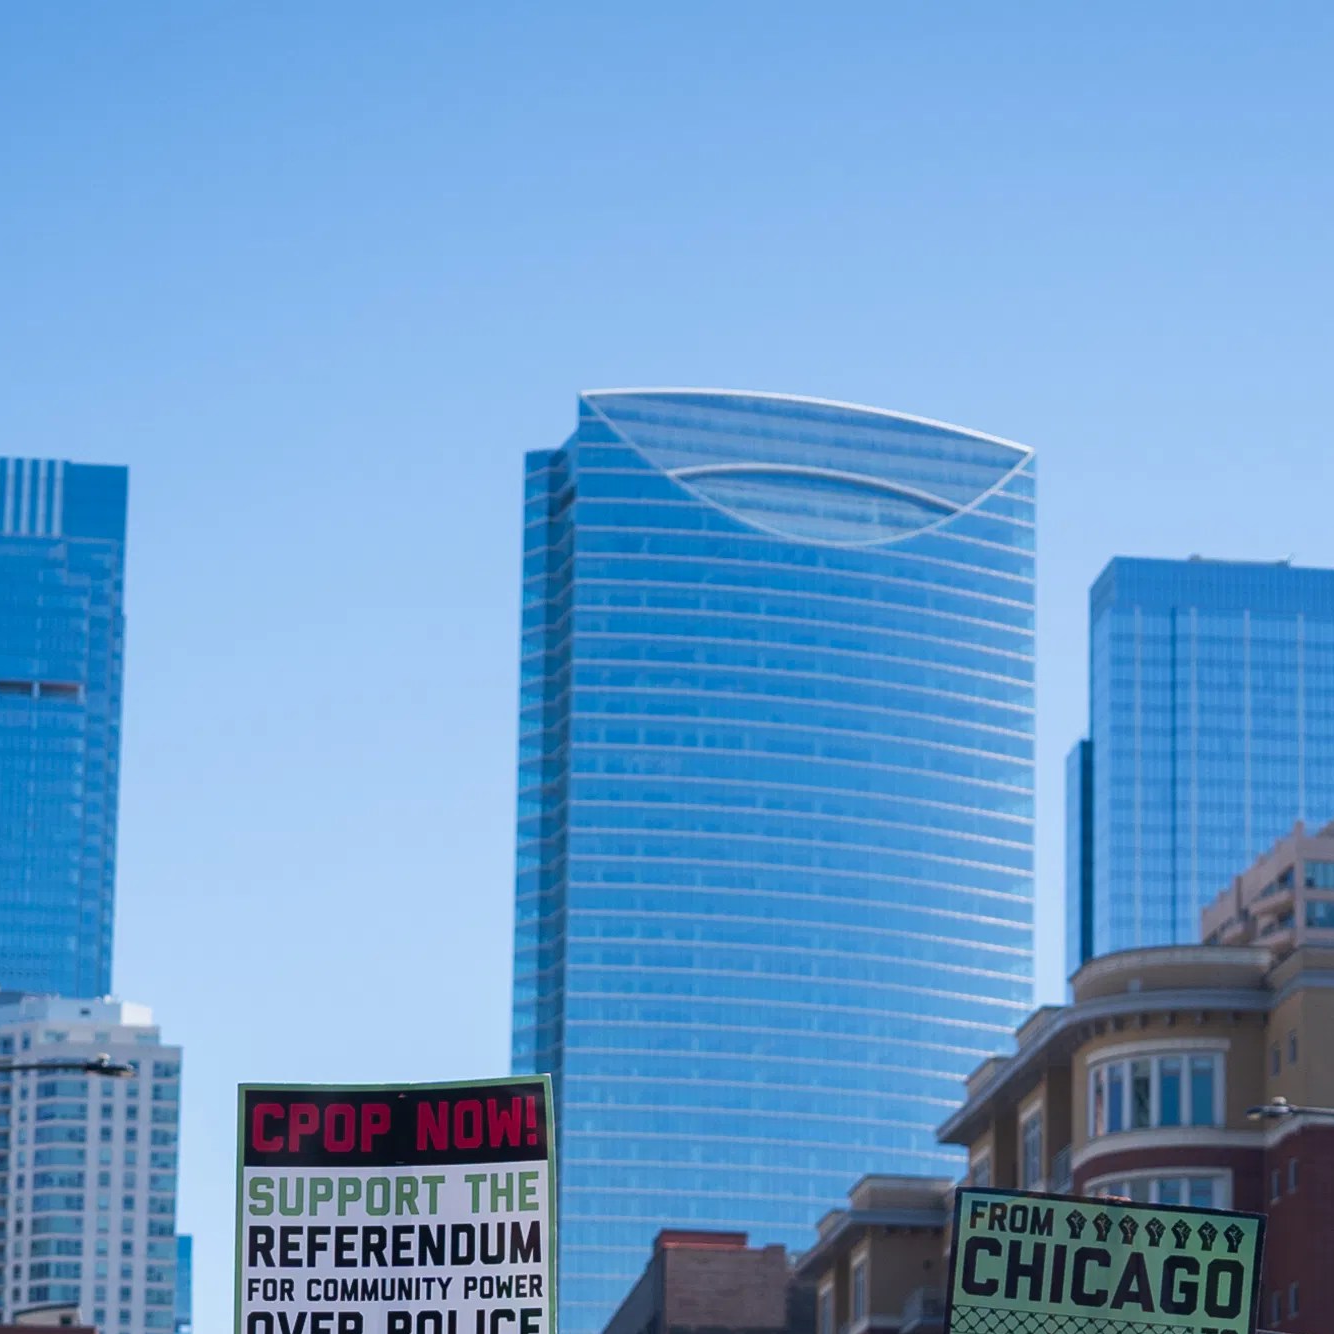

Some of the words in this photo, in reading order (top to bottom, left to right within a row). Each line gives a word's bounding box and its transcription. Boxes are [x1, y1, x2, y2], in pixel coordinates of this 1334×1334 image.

[252, 1102, 391, 1153] CPOP
[416, 1095, 538, 1151] NOW!
[247, 1175, 446, 1216] SUPPORT
[464, 1171, 540, 1214] THE
[969, 1200, 1055, 1237] FROM
[247, 1220, 542, 1267] REFERENDUM
[247, 1278, 295, 1302] FOR
[306, 1276, 453, 1301] COMMUNITY
[463, 1274, 543, 1299] POWER
[961, 1236, 1245, 1319] CHICAGO
